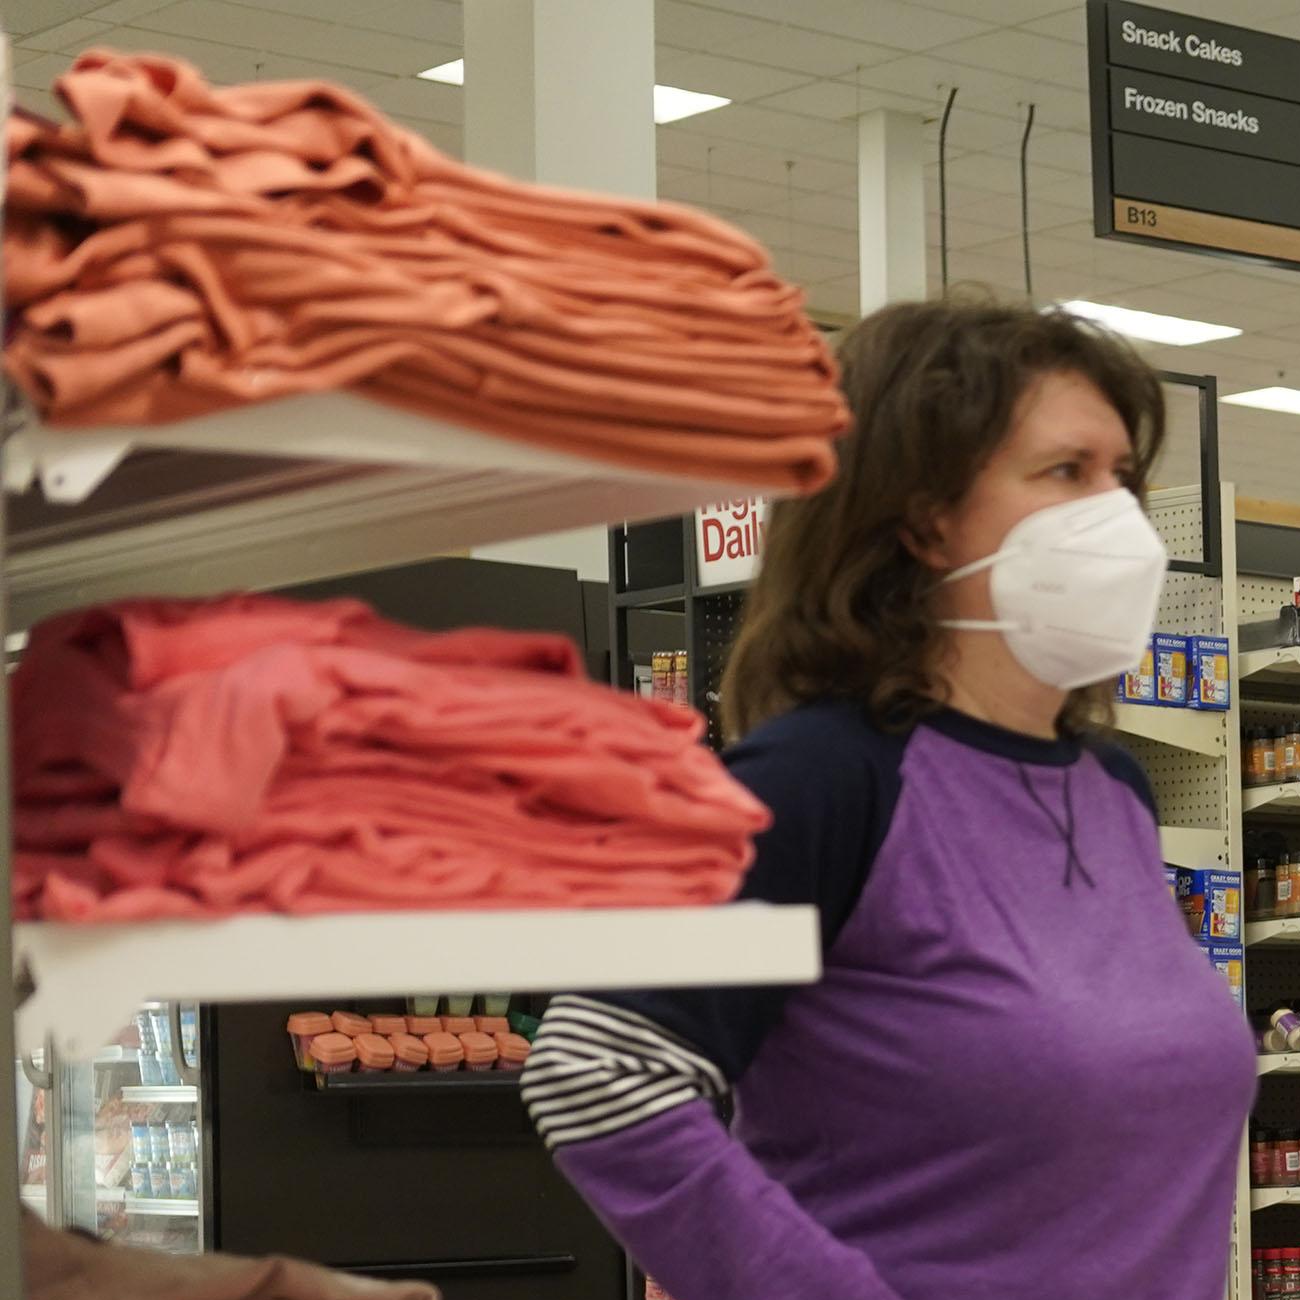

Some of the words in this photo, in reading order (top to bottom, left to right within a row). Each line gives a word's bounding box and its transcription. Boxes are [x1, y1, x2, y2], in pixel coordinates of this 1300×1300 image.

[1121, 21, 1181, 54] Snack
[1185, 34, 1243, 67] Cakes
[1125, 87, 1188, 121] Frozen
[1191, 101, 1259, 135] Snacks
[1127, 205, 1158, 228] B13
[702, 511, 764, 563] Dail
